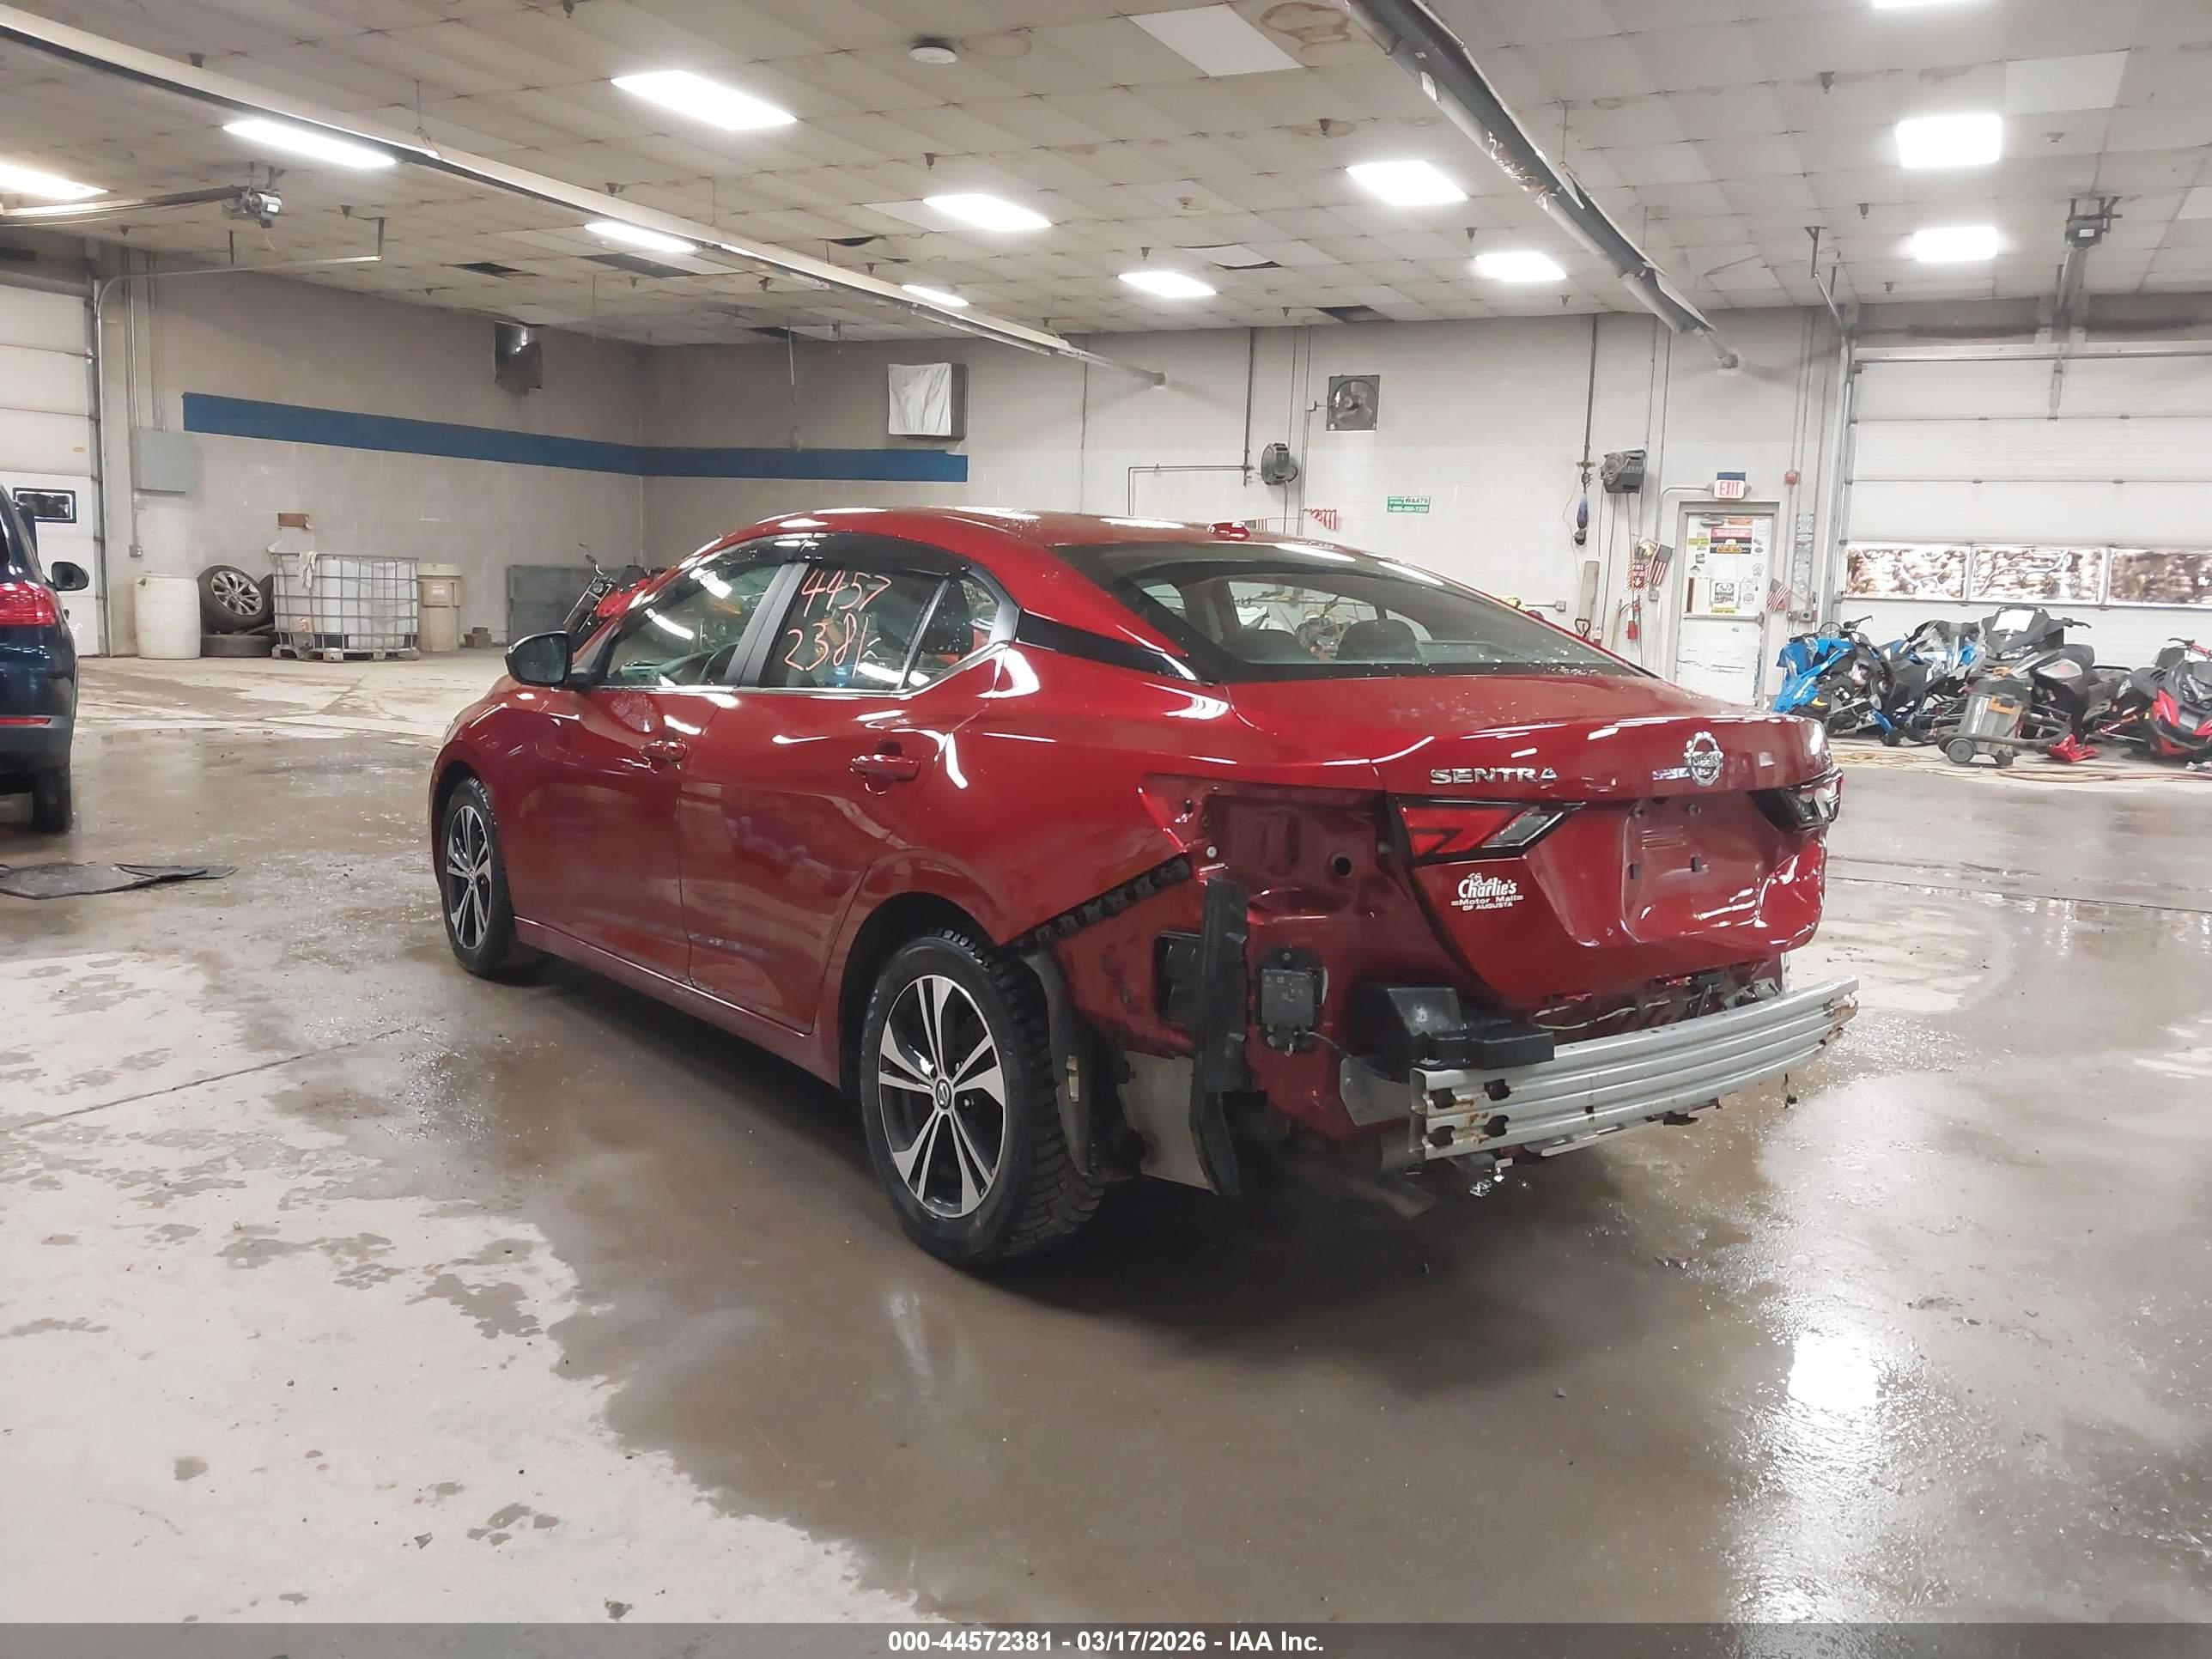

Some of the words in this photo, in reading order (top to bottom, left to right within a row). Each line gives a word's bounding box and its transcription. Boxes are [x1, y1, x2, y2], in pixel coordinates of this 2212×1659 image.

[1719, 481, 1741, 496] EXIT
[800, 568, 892, 618] 4457
[1430, 767, 1558, 785] SENTRA
[1458, 877, 1517, 898] Charlie's
[1476, 902, 1513, 910] AUGUSTA
